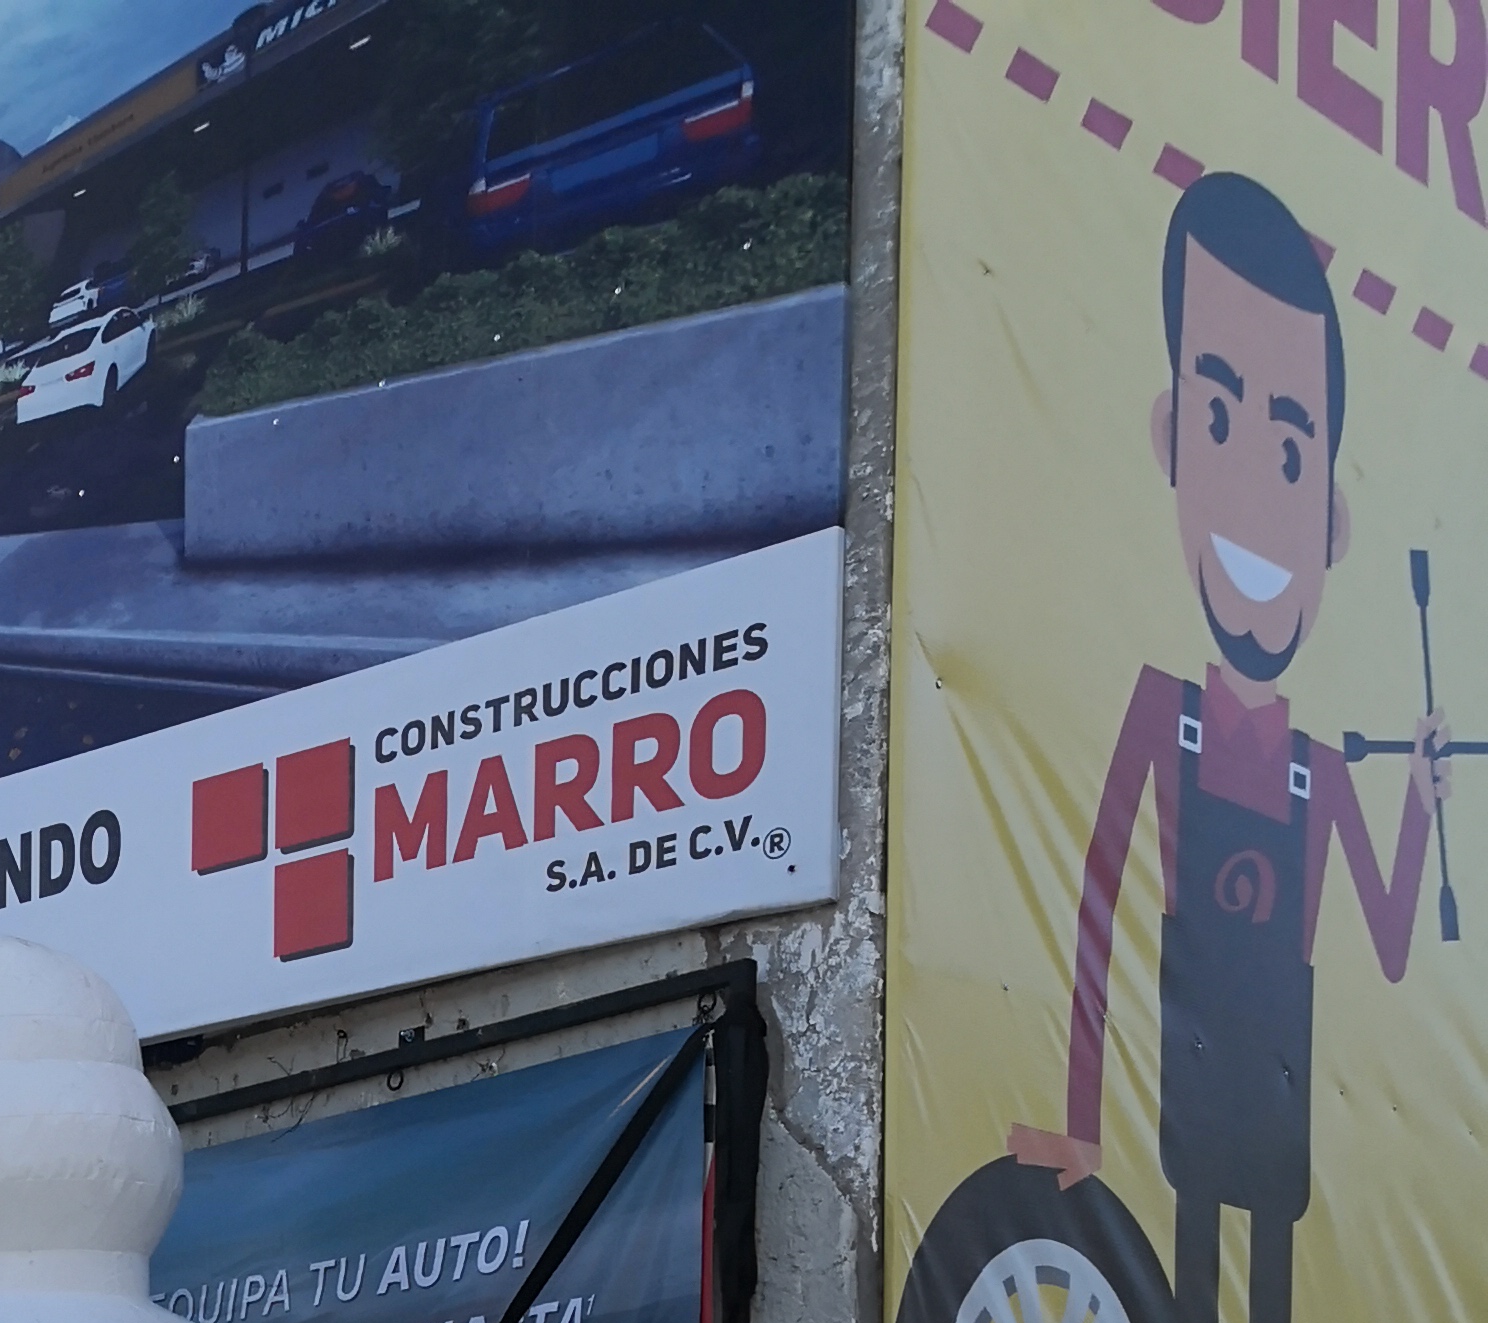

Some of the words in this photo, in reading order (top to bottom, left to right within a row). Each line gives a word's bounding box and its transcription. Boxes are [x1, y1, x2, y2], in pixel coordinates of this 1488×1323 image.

[374, 622, 769, 764] CONSTRUCCIONES
[372, 688, 768, 882] MARRO
[545, 851, 617, 893] S.A.
[628, 832, 679, 876] DE
[309, 1253, 367, 1307] TU
[376, 1219, 531, 1297] AUTO!
